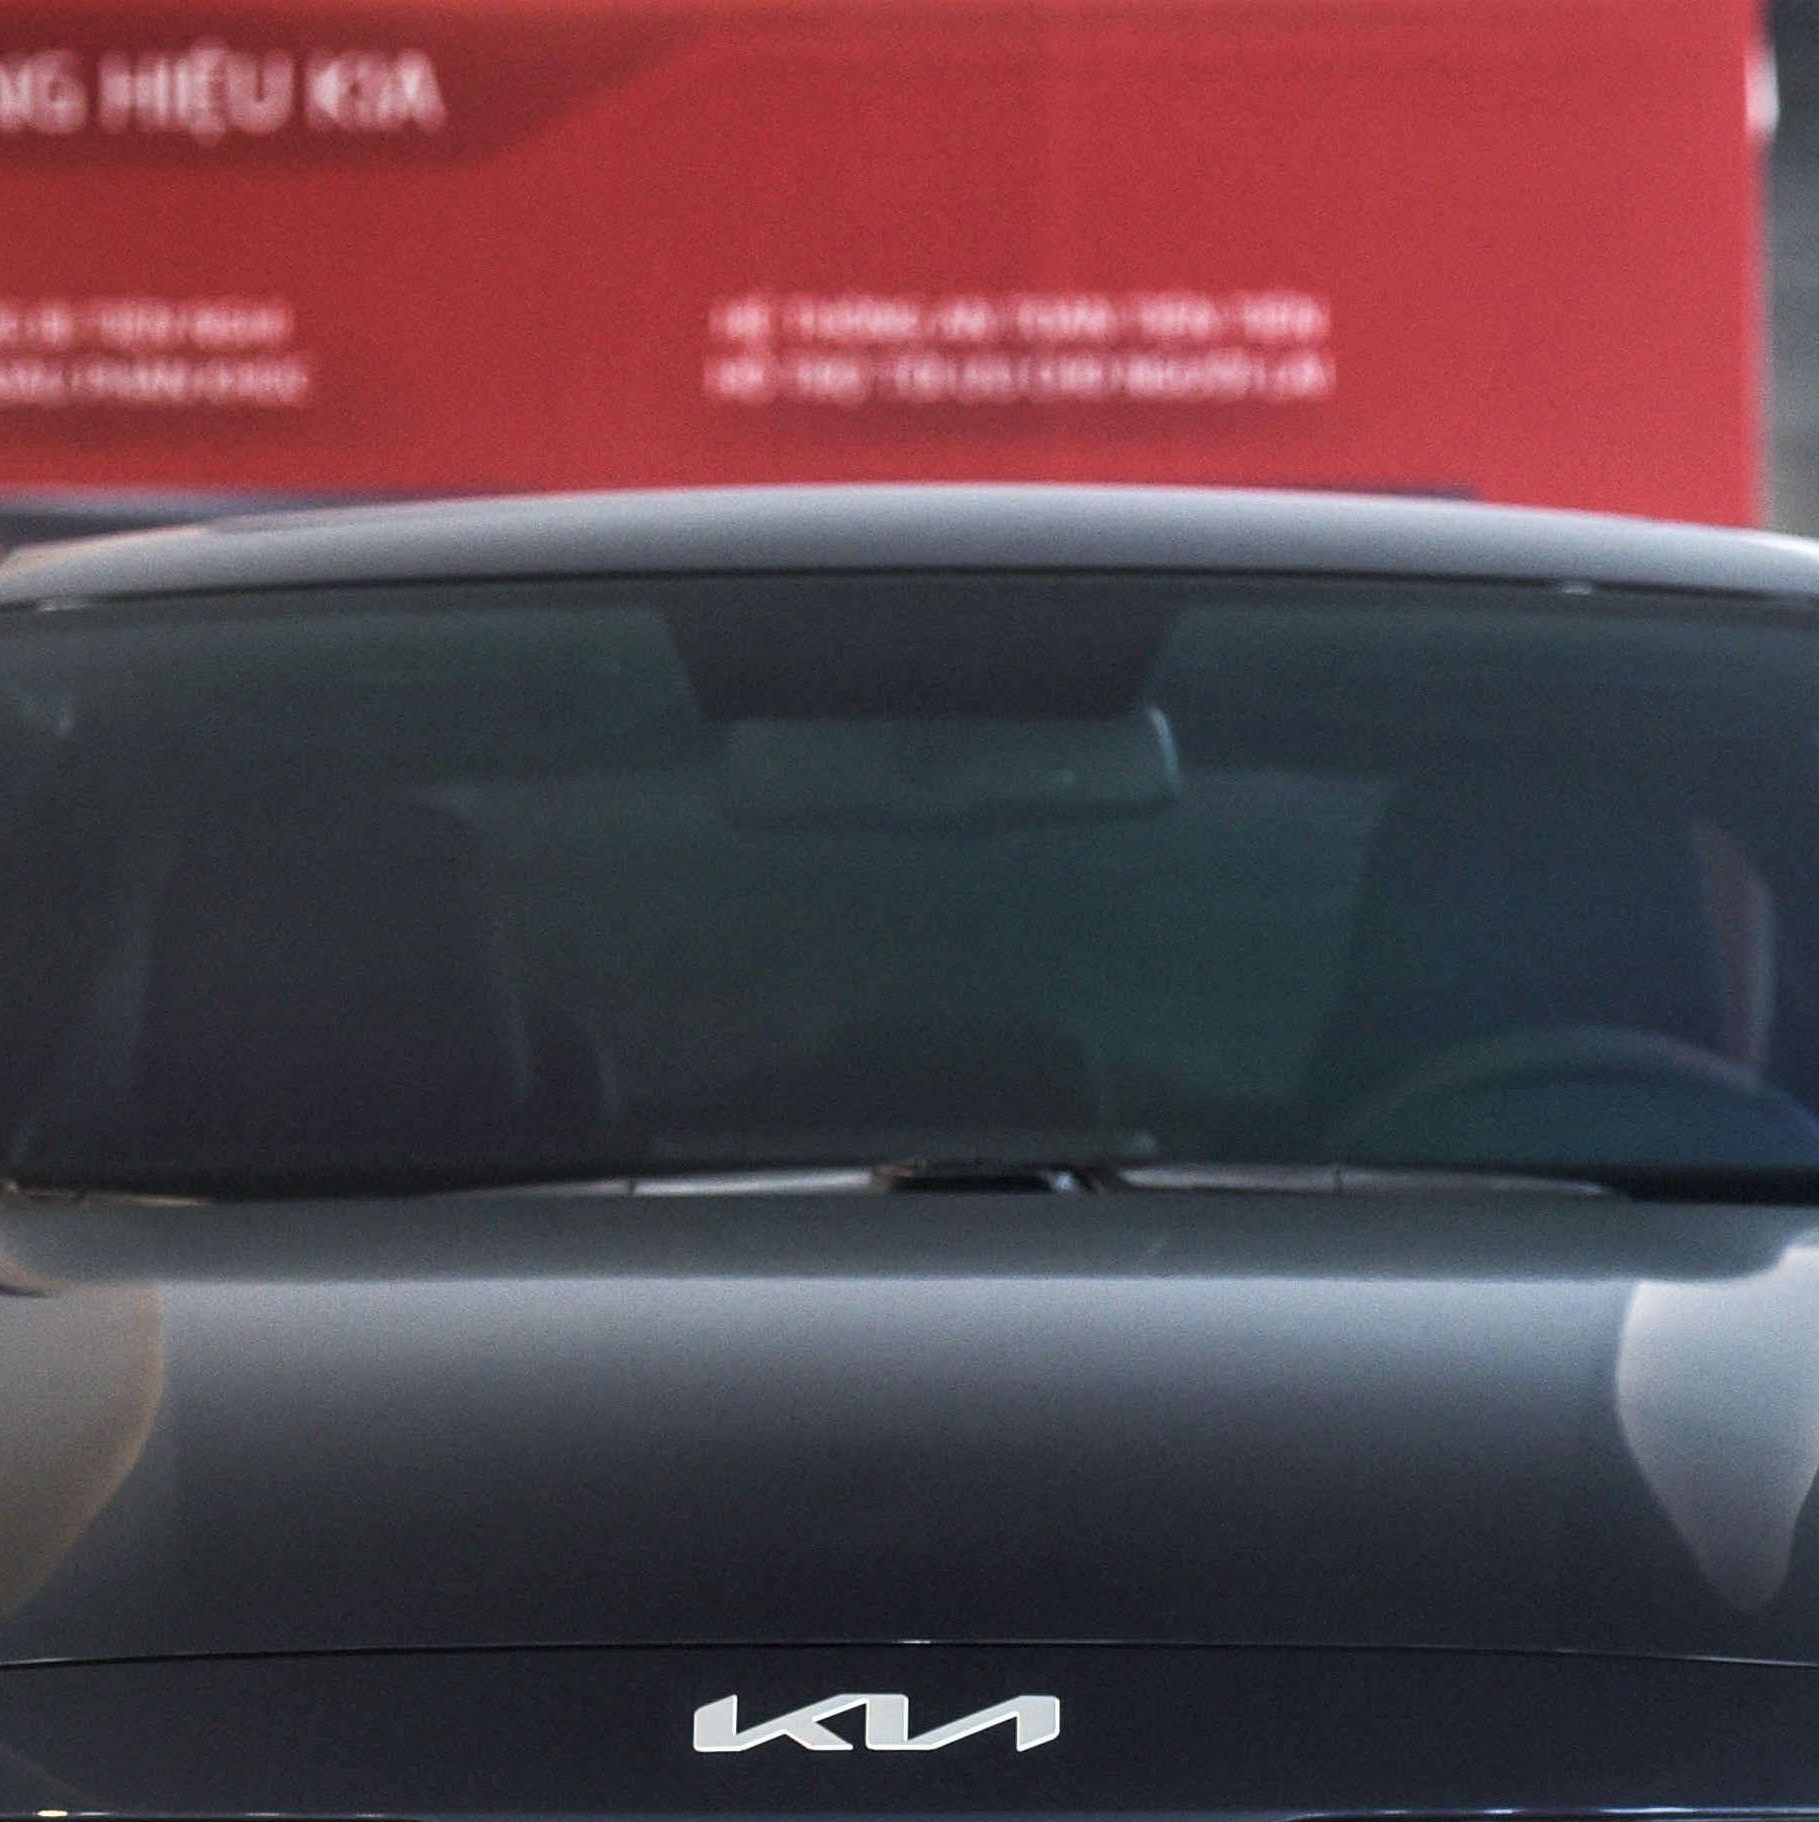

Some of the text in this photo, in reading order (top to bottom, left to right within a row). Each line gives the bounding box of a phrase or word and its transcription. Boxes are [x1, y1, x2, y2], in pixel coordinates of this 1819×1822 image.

[102, 42, 290, 141] HIỆU
[309, 52, 443, 129] KIA
[693, 1693, 1061, 1752] KIA
